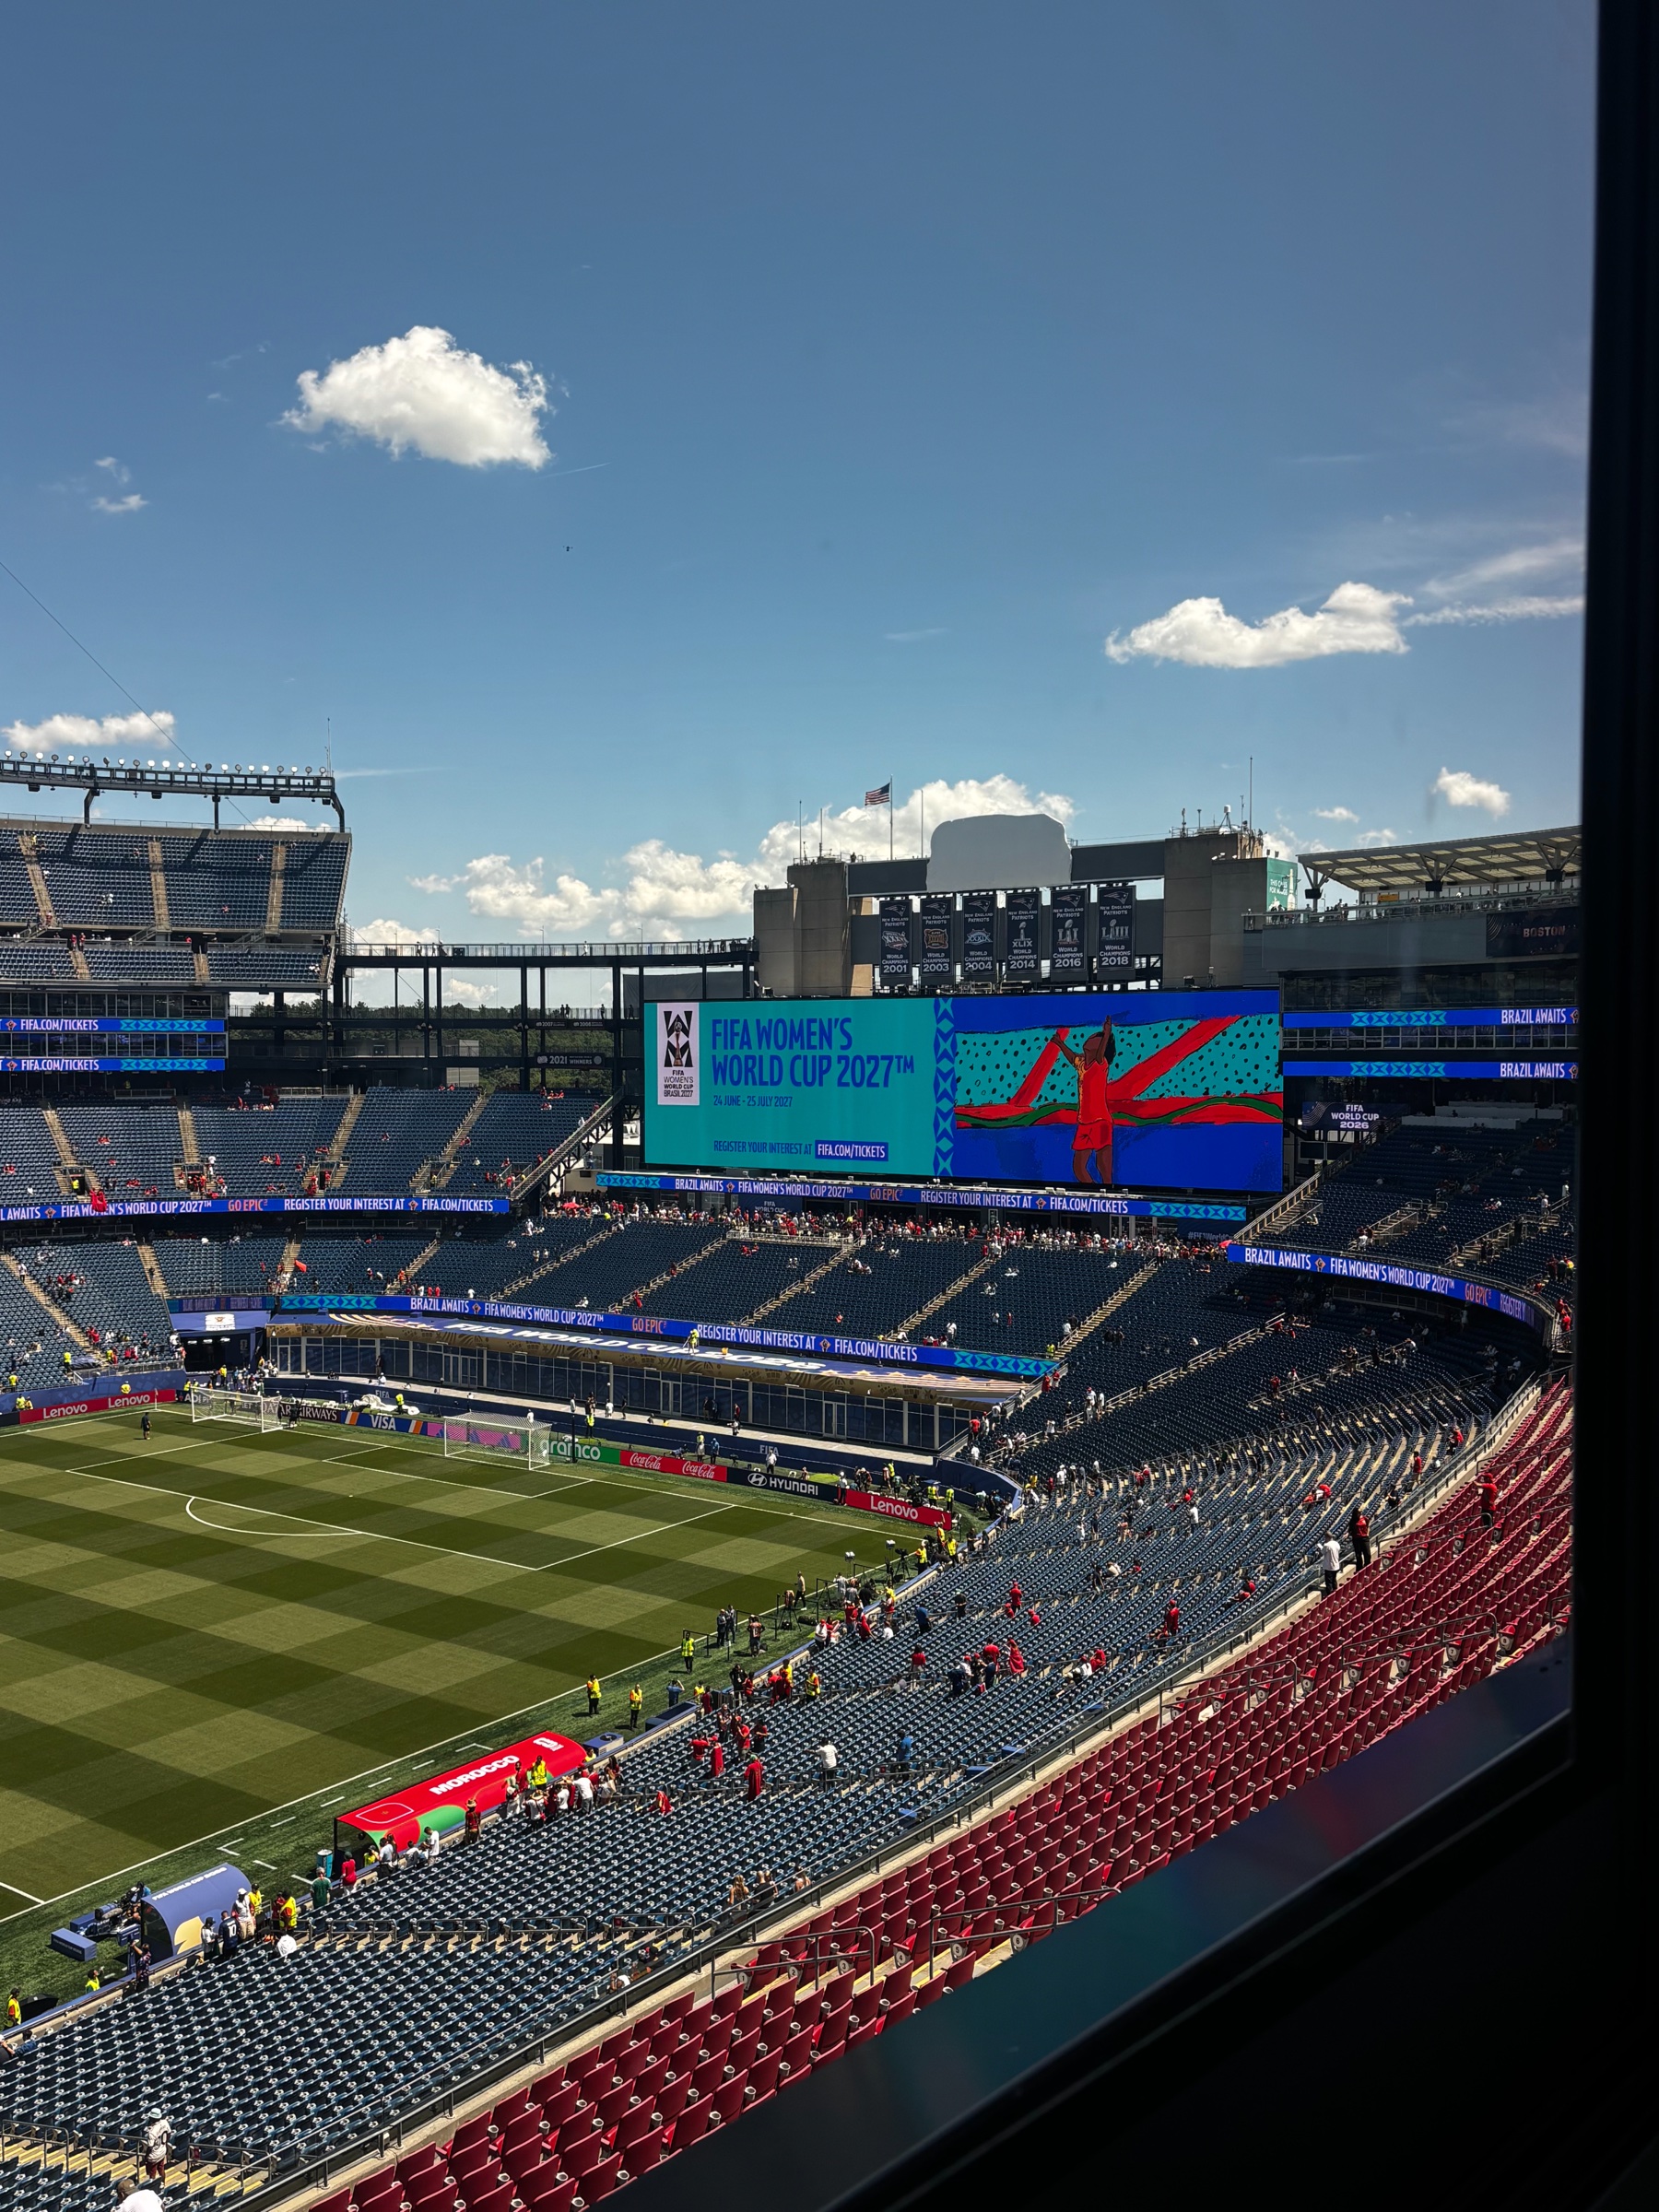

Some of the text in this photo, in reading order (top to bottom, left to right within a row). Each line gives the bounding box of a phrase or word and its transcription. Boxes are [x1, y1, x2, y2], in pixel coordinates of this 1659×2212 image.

[1523, 925, 1565, 938] BOSTON
[923, 964, 949, 972] 2003
[965, 962, 992, 970] 2004
[1010, 960, 1035, 969] 2014
[1055, 959, 1081, 967] 2016
[1101, 957, 1128, 966] 2018
[1501, 1008, 1567, 1024] BRAZIL AWAITS
[21, 1019, 99, 1030] FIFA.COM/TICKETS
[712, 1018, 852, 1050] FIFA WOMEN'S
[22, 1060, 99, 1071] FIFA.COM/TICKETS
[549, 1056, 567, 1064] 2021
[712, 1055, 783, 1086] WORLD
[790, 1055, 832, 1087] CUP
[1500, 1063, 1565, 1078] BRAZIL AWAITS
[713, 1095, 793, 1107] 24 JUNE 25 JULY 2027
[714, 1141, 885, 1159] REGISTER YOUR INTEREST AT FIFA.COM/TICKETS
[675, 1179, 699, 1190] BRAZIL
[699, 1180, 723, 1191] AWAITS
[739, 1182, 752, 1193] FIFA
[753, 1182, 784, 1195] WOMEN'S
[786, 1184, 811, 1196] WORLD
[812, 1185, 826, 1197] CUP
[870, 1188, 882, 1200] GO
[921, 1191, 958, 1205] REGISTER
[959, 1193, 981, 1206] YOUR
[983, 1193, 1020, 1208] INTEREST
[1022, 1196, 1032, 1208] AT
[1050, 1198, 1128, 1213] FIFA.COM/TICKETS
[7, 1207, 41, 1220] AWAITS
[61, 1204, 80, 1217] FIFA
[125, 1202, 157, 1214] WORLD
[160, 1201, 178, 1214] CUP
[228, 1200, 241, 1211] GO
[284, 1199, 326, 1210] REGISTER
[327, 1199, 352, 1210] YOUR
[354, 1199, 393, 1210] INTEREST
[394, 1199, 404, 1210] AT
[422, 1199, 493, 1211] FIFA.COM/TICKETS
[1245, 1248, 1277, 1266] BRAZIL
[1278, 1252, 1311, 1270] AWAITS
[1330, 1257, 1348, 1276] FIFA
[1349, 1260, 1387, 1281] WOMEN'S
[1388, 1267, 1414, 1287] WORLD
[1415, 1270, 1430, 1290] CUP
[1465, 1283, 1474, 1300] GO
[1500, 1294, 1522, 1319] REGISTER
[411, 1298, 440, 1310] BRAZIL
[441, 1300, 470, 1313] AWAITS
[485, 1303, 499, 1316] FIFA
[499, 1305, 532, 1320] WOMEN'S
[533, 1307, 559, 1323] WORLD
[561, 1310, 576, 1324] CUP
[632, 1317, 644, 1332] GO
[698, 1324, 737, 1341] REGISTER
[738, 1328, 761, 1344] YOUR
[764, 1331, 804, 1349] INTEREST
[806, 1335, 816, 1350] AT
[834, 1339, 918, 1361] FIFA.COM/TICKETS
[444, 1323, 826, 1370] FIFA WORLD CUP 2026
[108, 1394, 150, 1409] Lenovo
[375, 1390, 390, 1399] FIFA
[43, 1404, 88, 1419] Lenovo
[299, 1406, 337, 1421] IRWAYS
[370, 1415, 396, 1430] VISA
[769, 1478, 818, 1496] HYUNDAI
[871, 1495, 918, 1520] Lenovo
[429, 1755, 520, 1795] MOROCCO
[228, 1924, 236, 1938] 10
